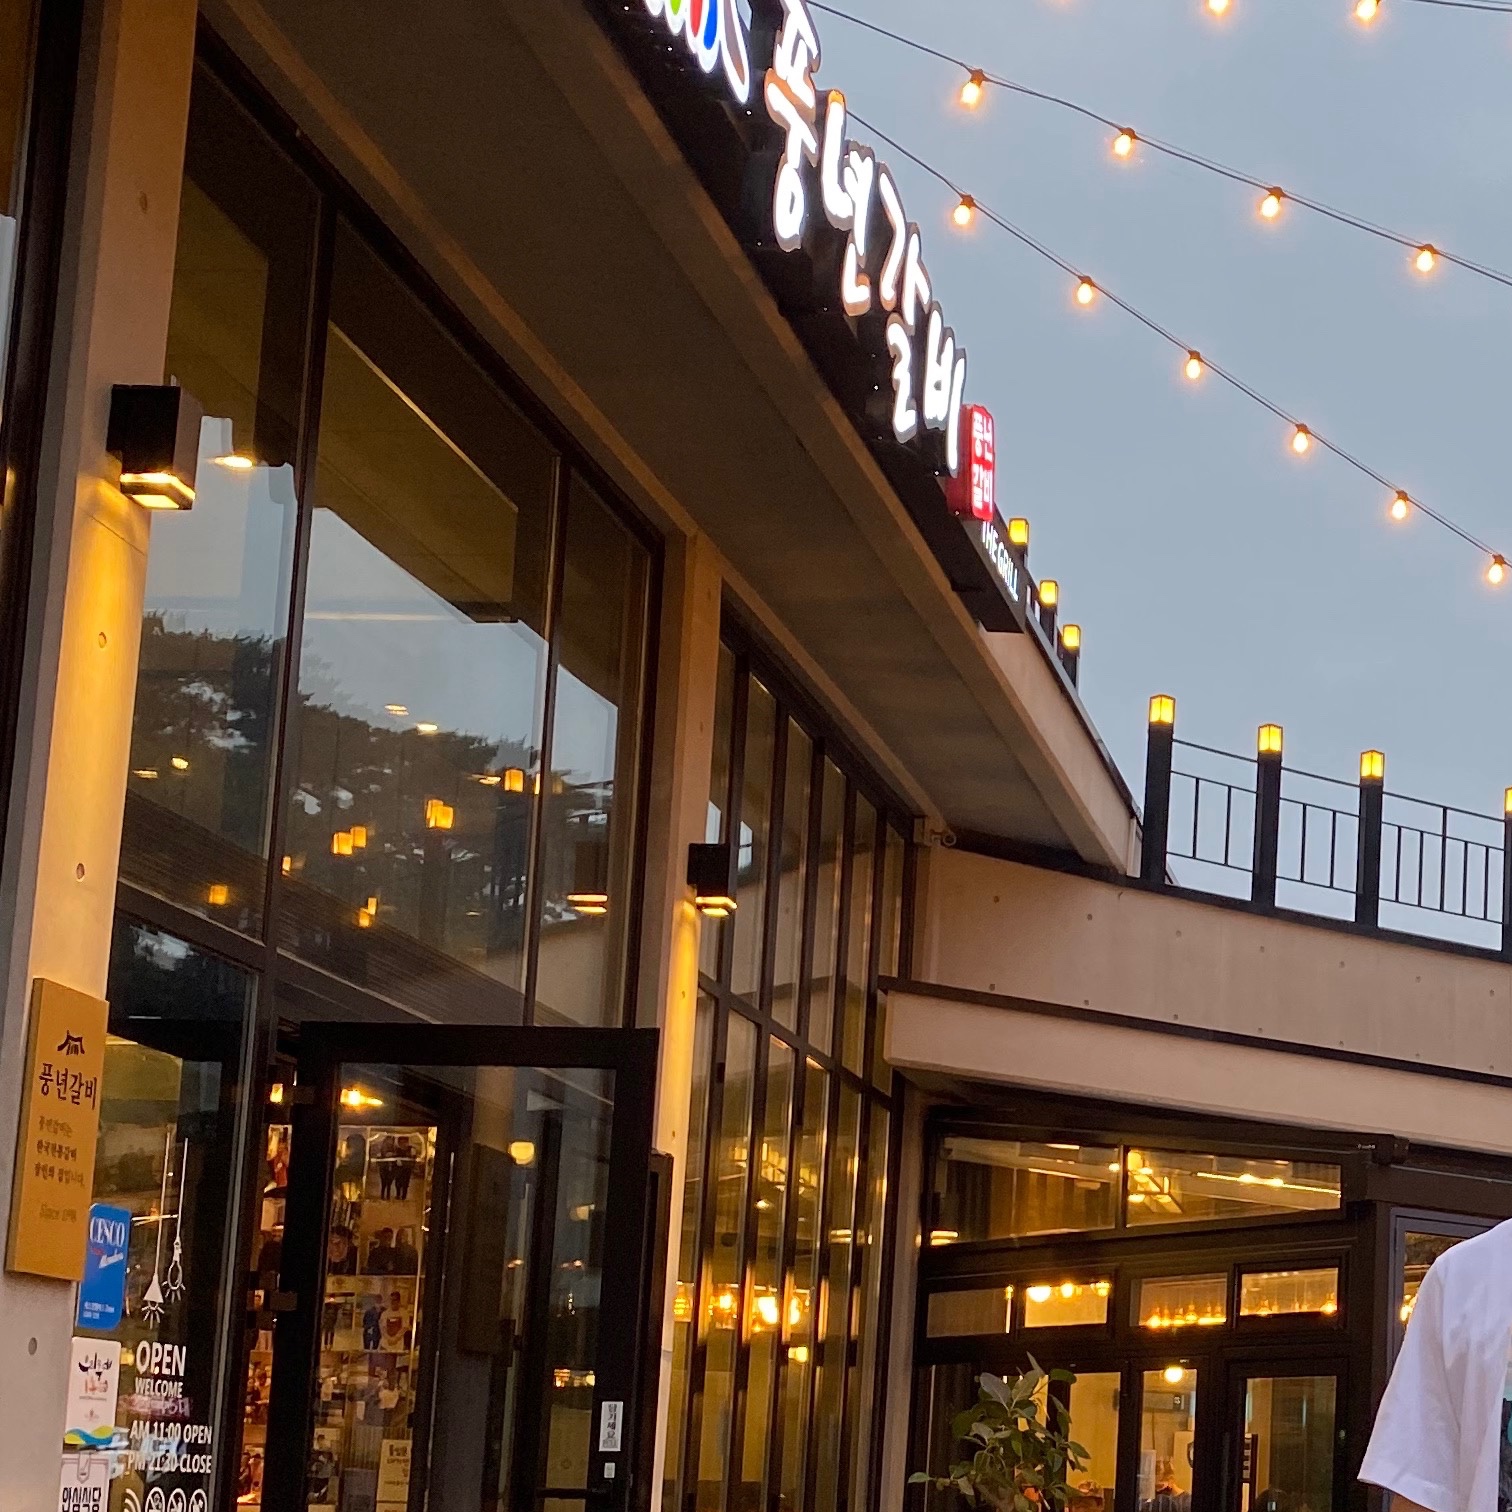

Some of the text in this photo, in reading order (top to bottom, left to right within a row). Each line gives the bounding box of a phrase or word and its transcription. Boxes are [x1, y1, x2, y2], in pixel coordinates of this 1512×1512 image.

[766, 0, 966, 476] 풍년갈비
[981, 520, 1020, 601] THE GRILL
[39, 1062, 98, 1111] 풍년갈비
[136, 1340, 187, 1377] OPEN
[135, 1376, 183, 1399] WELCOME
[130, 1420, 213, 1445] AM 11:00 OPEN
[179, 1453, 212, 1474] CLOSE
